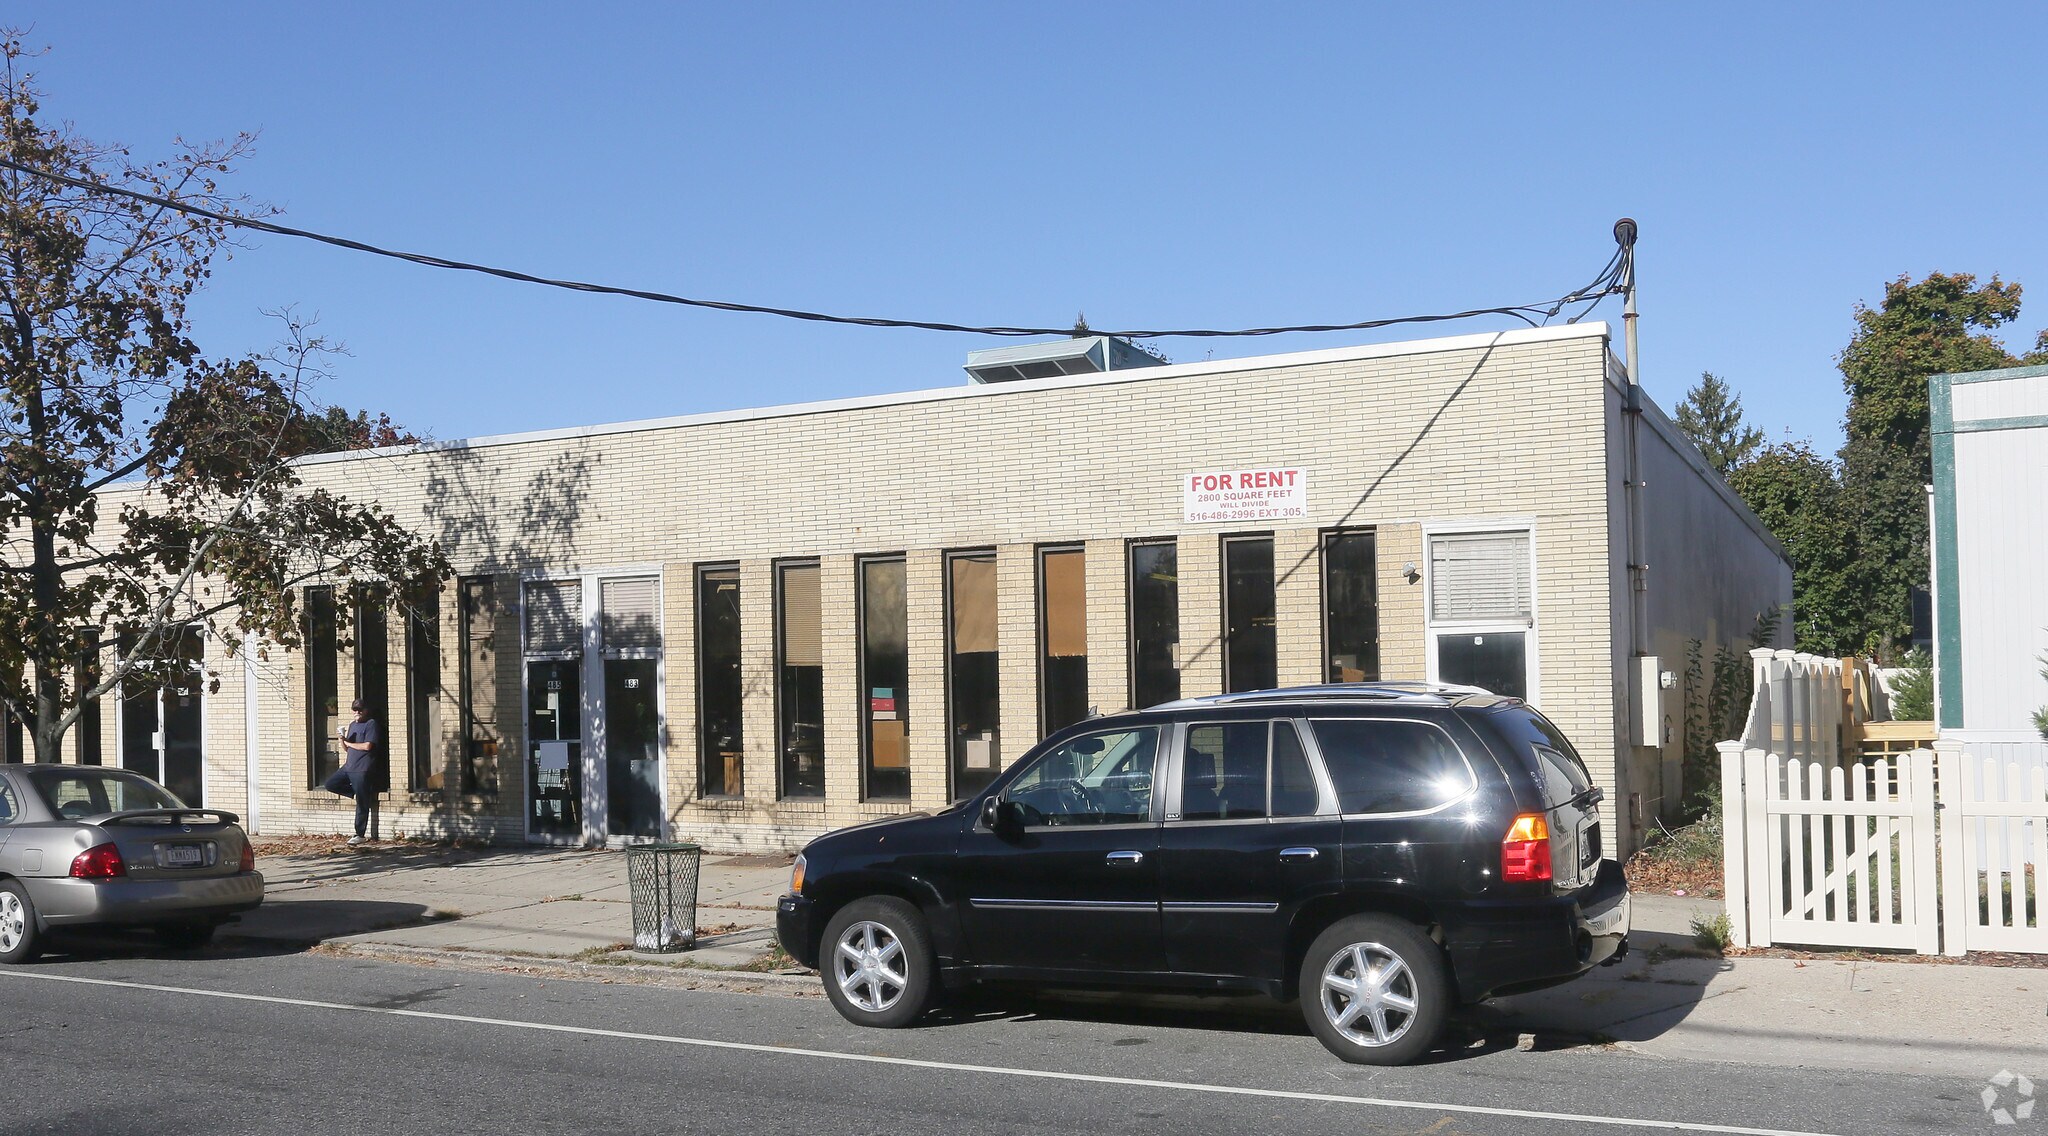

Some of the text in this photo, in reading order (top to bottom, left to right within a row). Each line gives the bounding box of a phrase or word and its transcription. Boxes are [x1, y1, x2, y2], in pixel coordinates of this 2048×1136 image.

[1192, 470, 1298, 491] FOR RENT
[1198, 489, 1292, 502] 2800 SQUARE FEET
[1190, 507, 1301, 521] 516-486-2996 EXT 305
